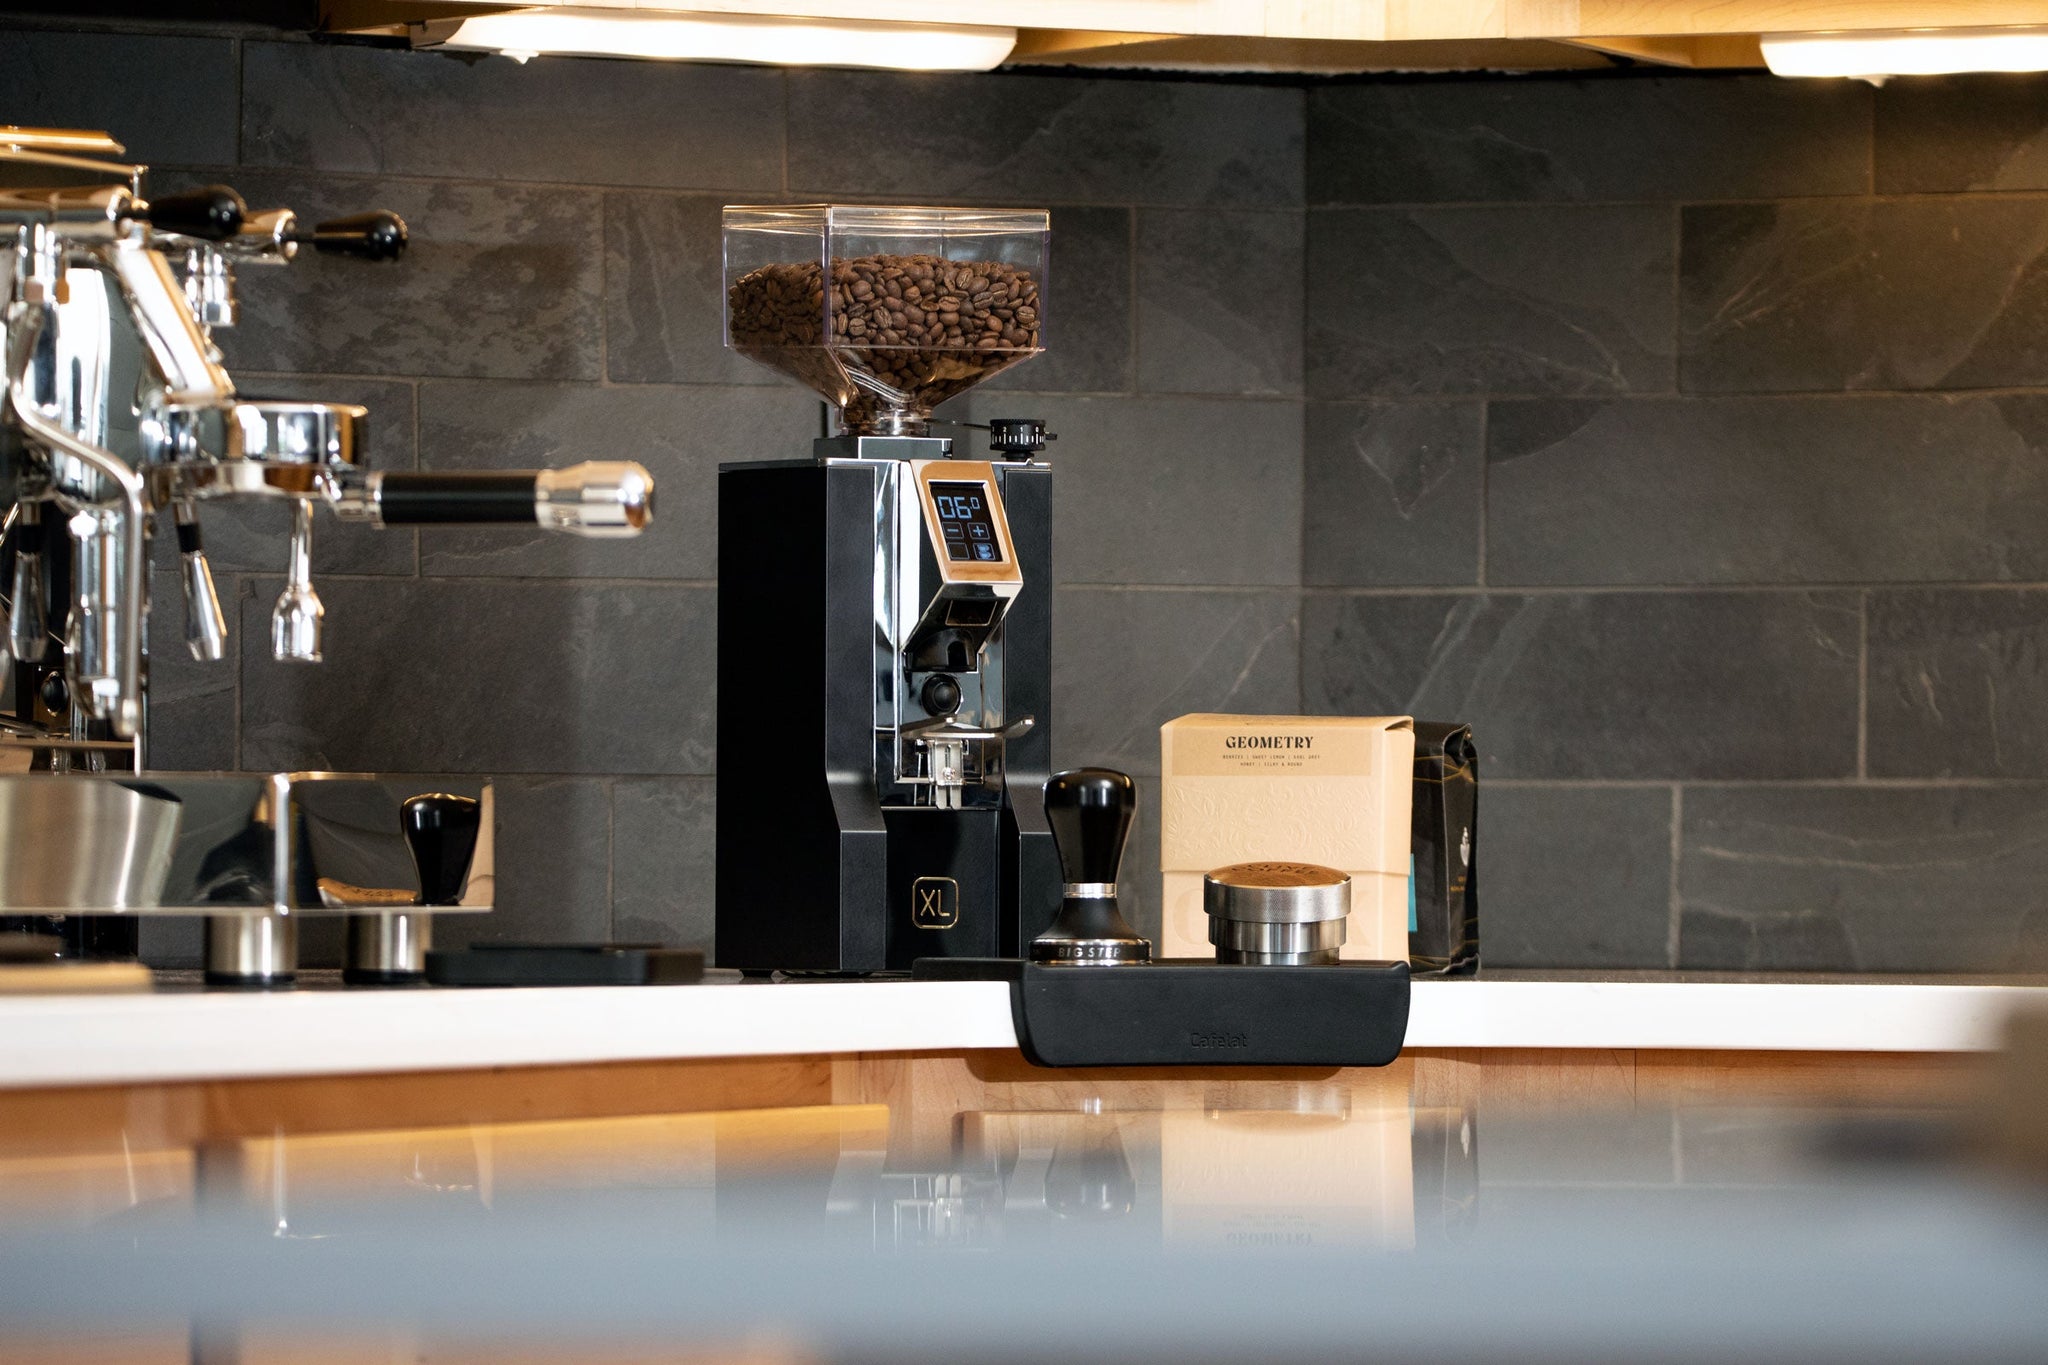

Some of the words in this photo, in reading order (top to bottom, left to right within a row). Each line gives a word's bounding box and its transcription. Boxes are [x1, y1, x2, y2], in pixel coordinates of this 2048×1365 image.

[1225, 736, 1313, 748] GEOMETRY
[920, 889, 950, 917] XL
[1058, 947, 1084, 958] BIG
[1087, 947, 1121, 958] STEP
[1190, 1032, 1248, 1049] Cafelat
